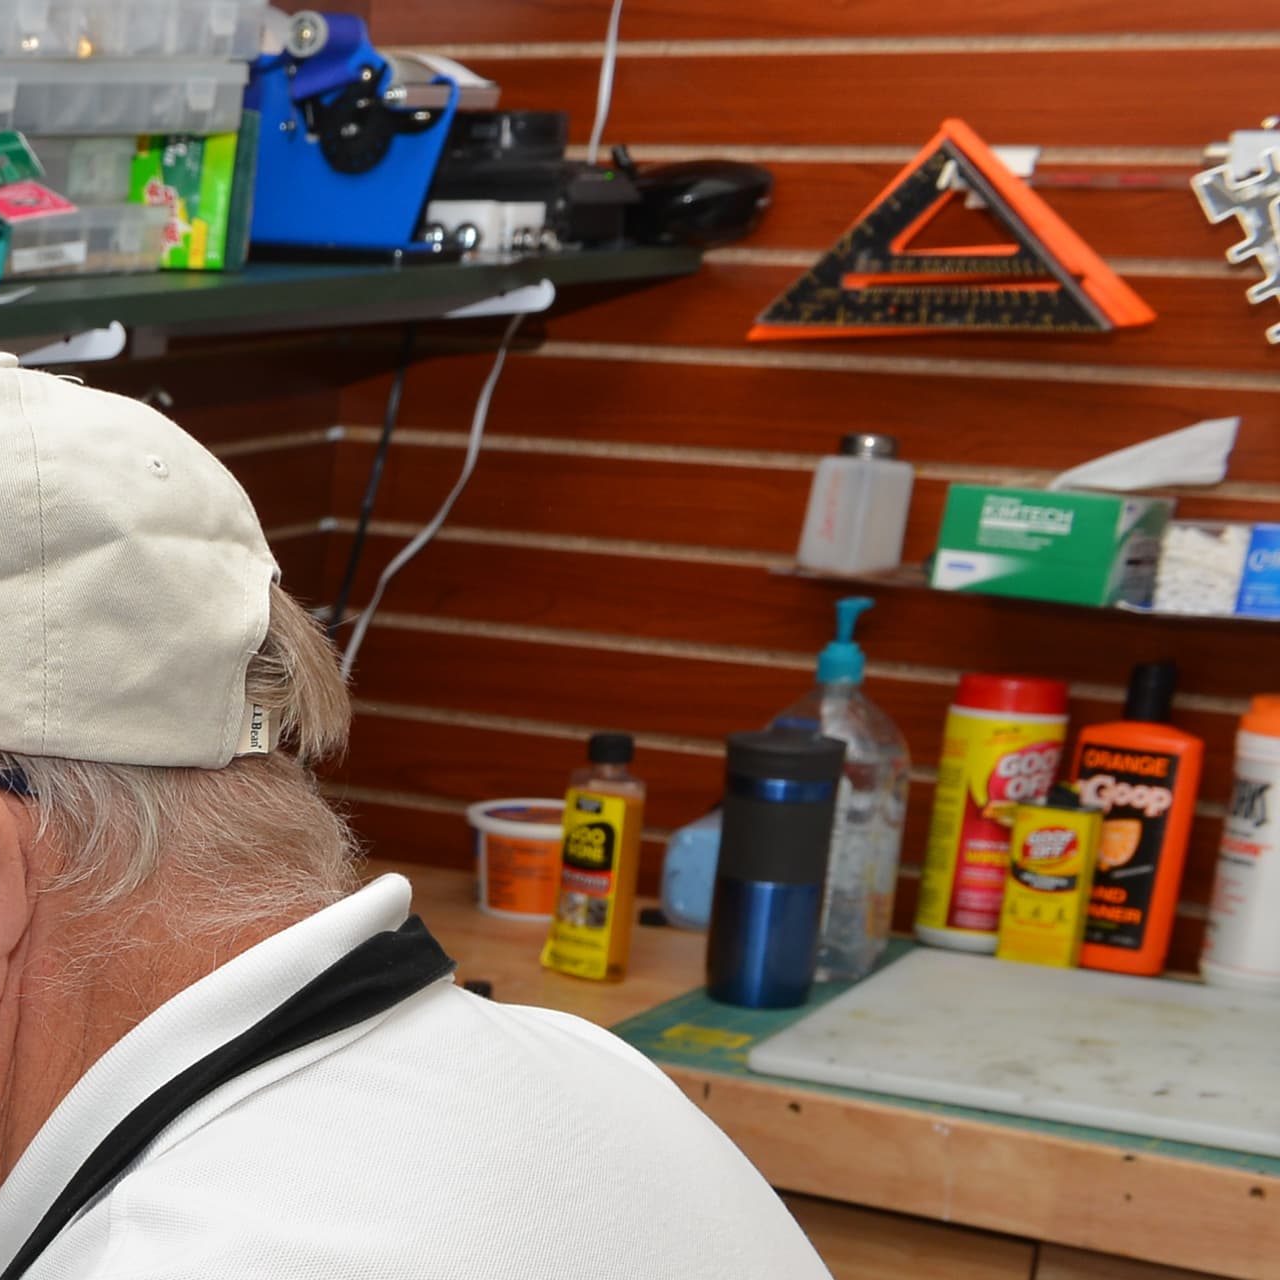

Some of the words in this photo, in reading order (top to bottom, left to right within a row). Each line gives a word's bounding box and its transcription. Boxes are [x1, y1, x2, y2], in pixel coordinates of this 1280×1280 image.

[981, 504, 1074, 528] KIMTECH
[1085, 749, 1169, 778] ORANGE
[1080, 774, 1173, 818] Goop
